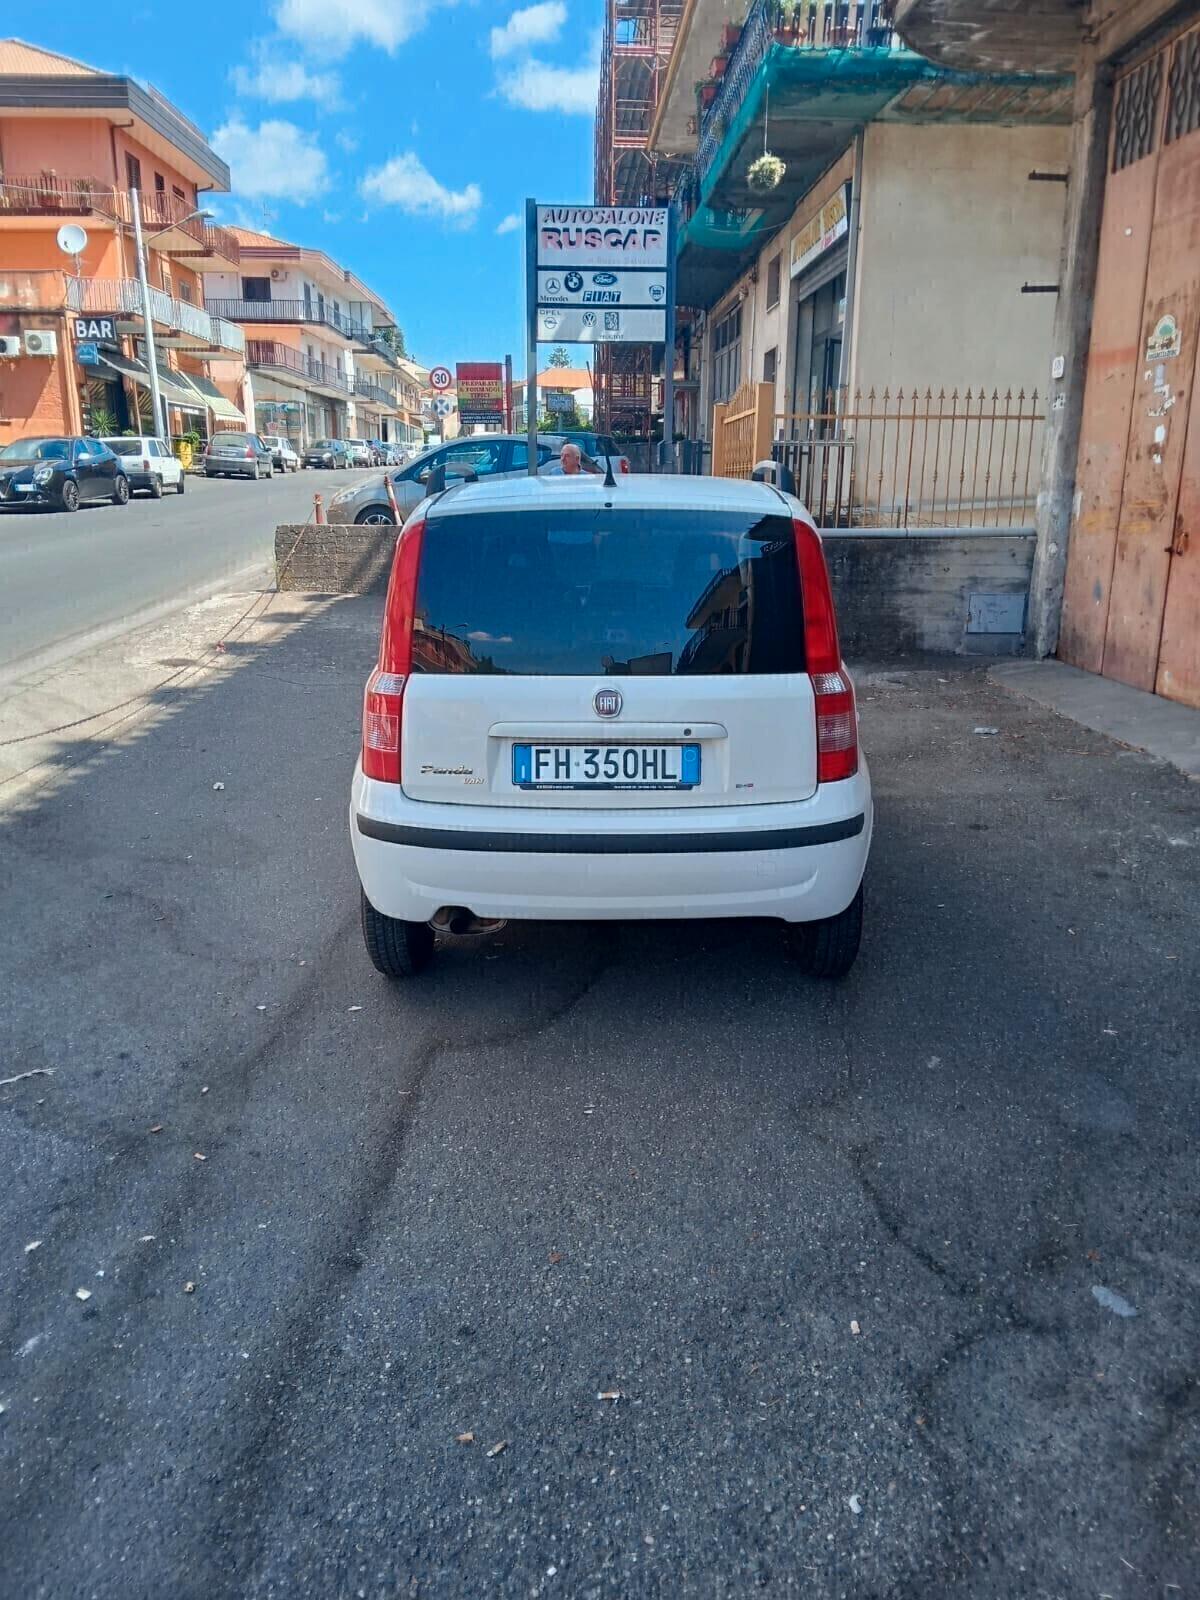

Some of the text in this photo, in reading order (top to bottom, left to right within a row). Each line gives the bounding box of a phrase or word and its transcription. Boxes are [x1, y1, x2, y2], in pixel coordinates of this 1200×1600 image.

[543, 208, 666, 225] AUTOSALONE
[582, 290, 621, 303] FIAT
[75, 320, 113, 338] BAR
[434, 373, 447, 385] 30
[599, 696, 617, 711] FIAT
[420, 764, 473, 775] Panda
[535, 748, 572, 779] FH
[583, 748, 678, 780] 350HL
